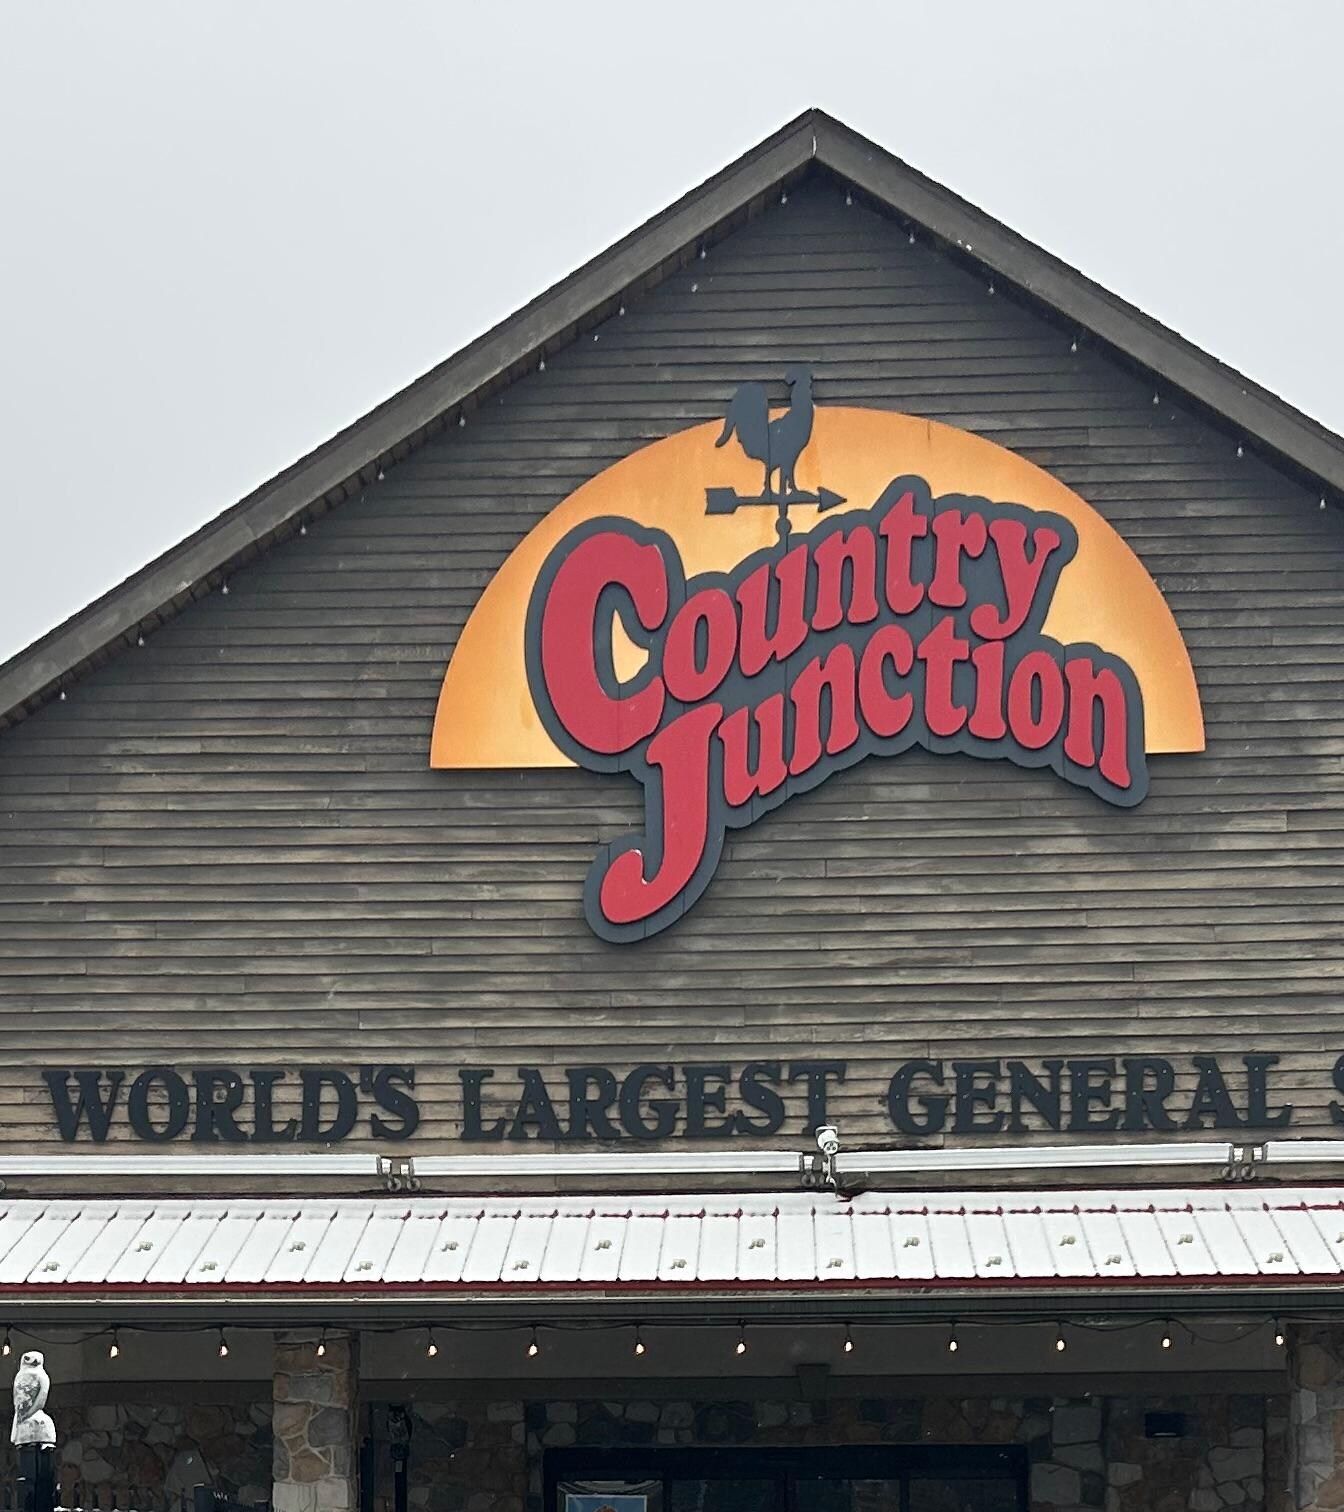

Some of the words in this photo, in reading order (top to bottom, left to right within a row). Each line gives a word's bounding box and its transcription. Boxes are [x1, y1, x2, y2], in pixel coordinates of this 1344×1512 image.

[542, 490, 1061, 754] Country
[600, 615, 1131, 924] Junction
[43, 1063, 420, 1142] WORLD'S
[459, 1061, 846, 1141] LARGEST
[887, 1055, 1291, 1134] GENERAL
